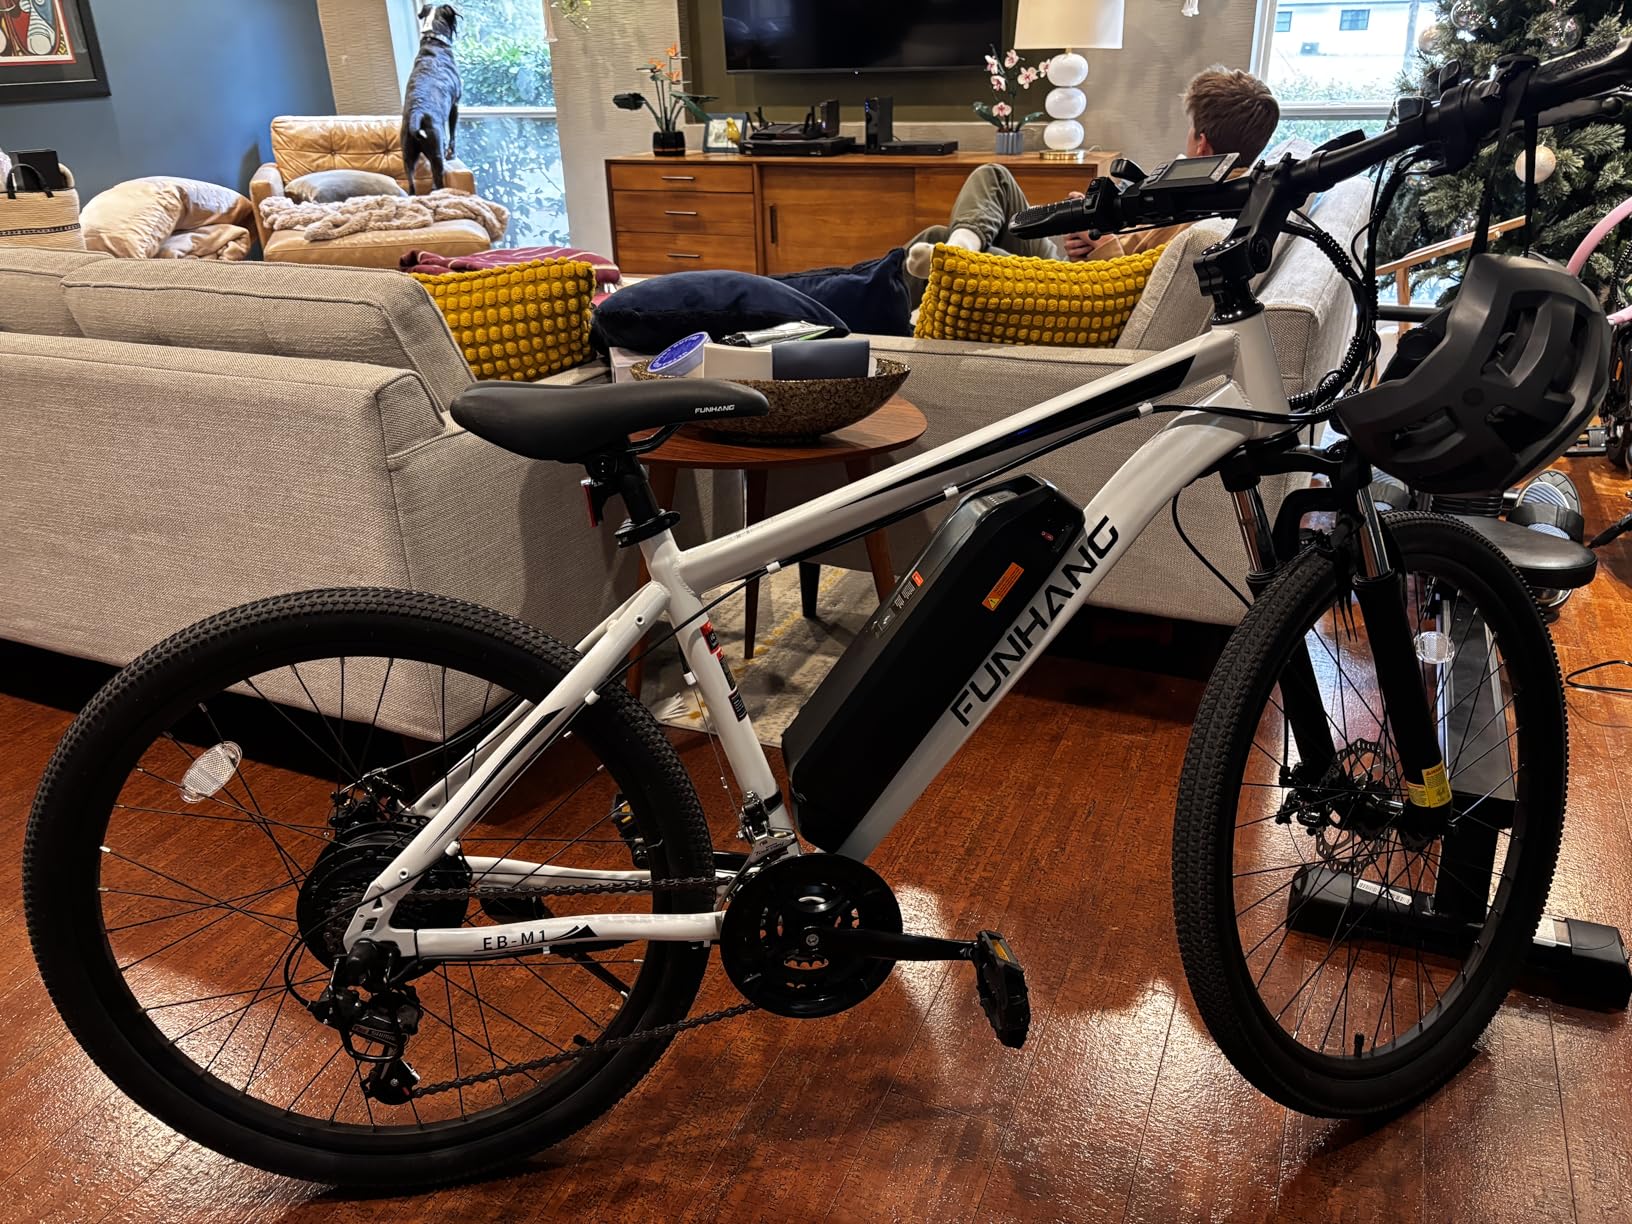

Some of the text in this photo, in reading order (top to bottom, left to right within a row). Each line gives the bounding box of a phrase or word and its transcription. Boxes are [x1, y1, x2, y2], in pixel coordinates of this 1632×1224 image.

[694, 404, 736, 414] FUNHANG
[950, 515, 1119, 727] FUNHANG
[483, 929, 546, 950] EB-M1
